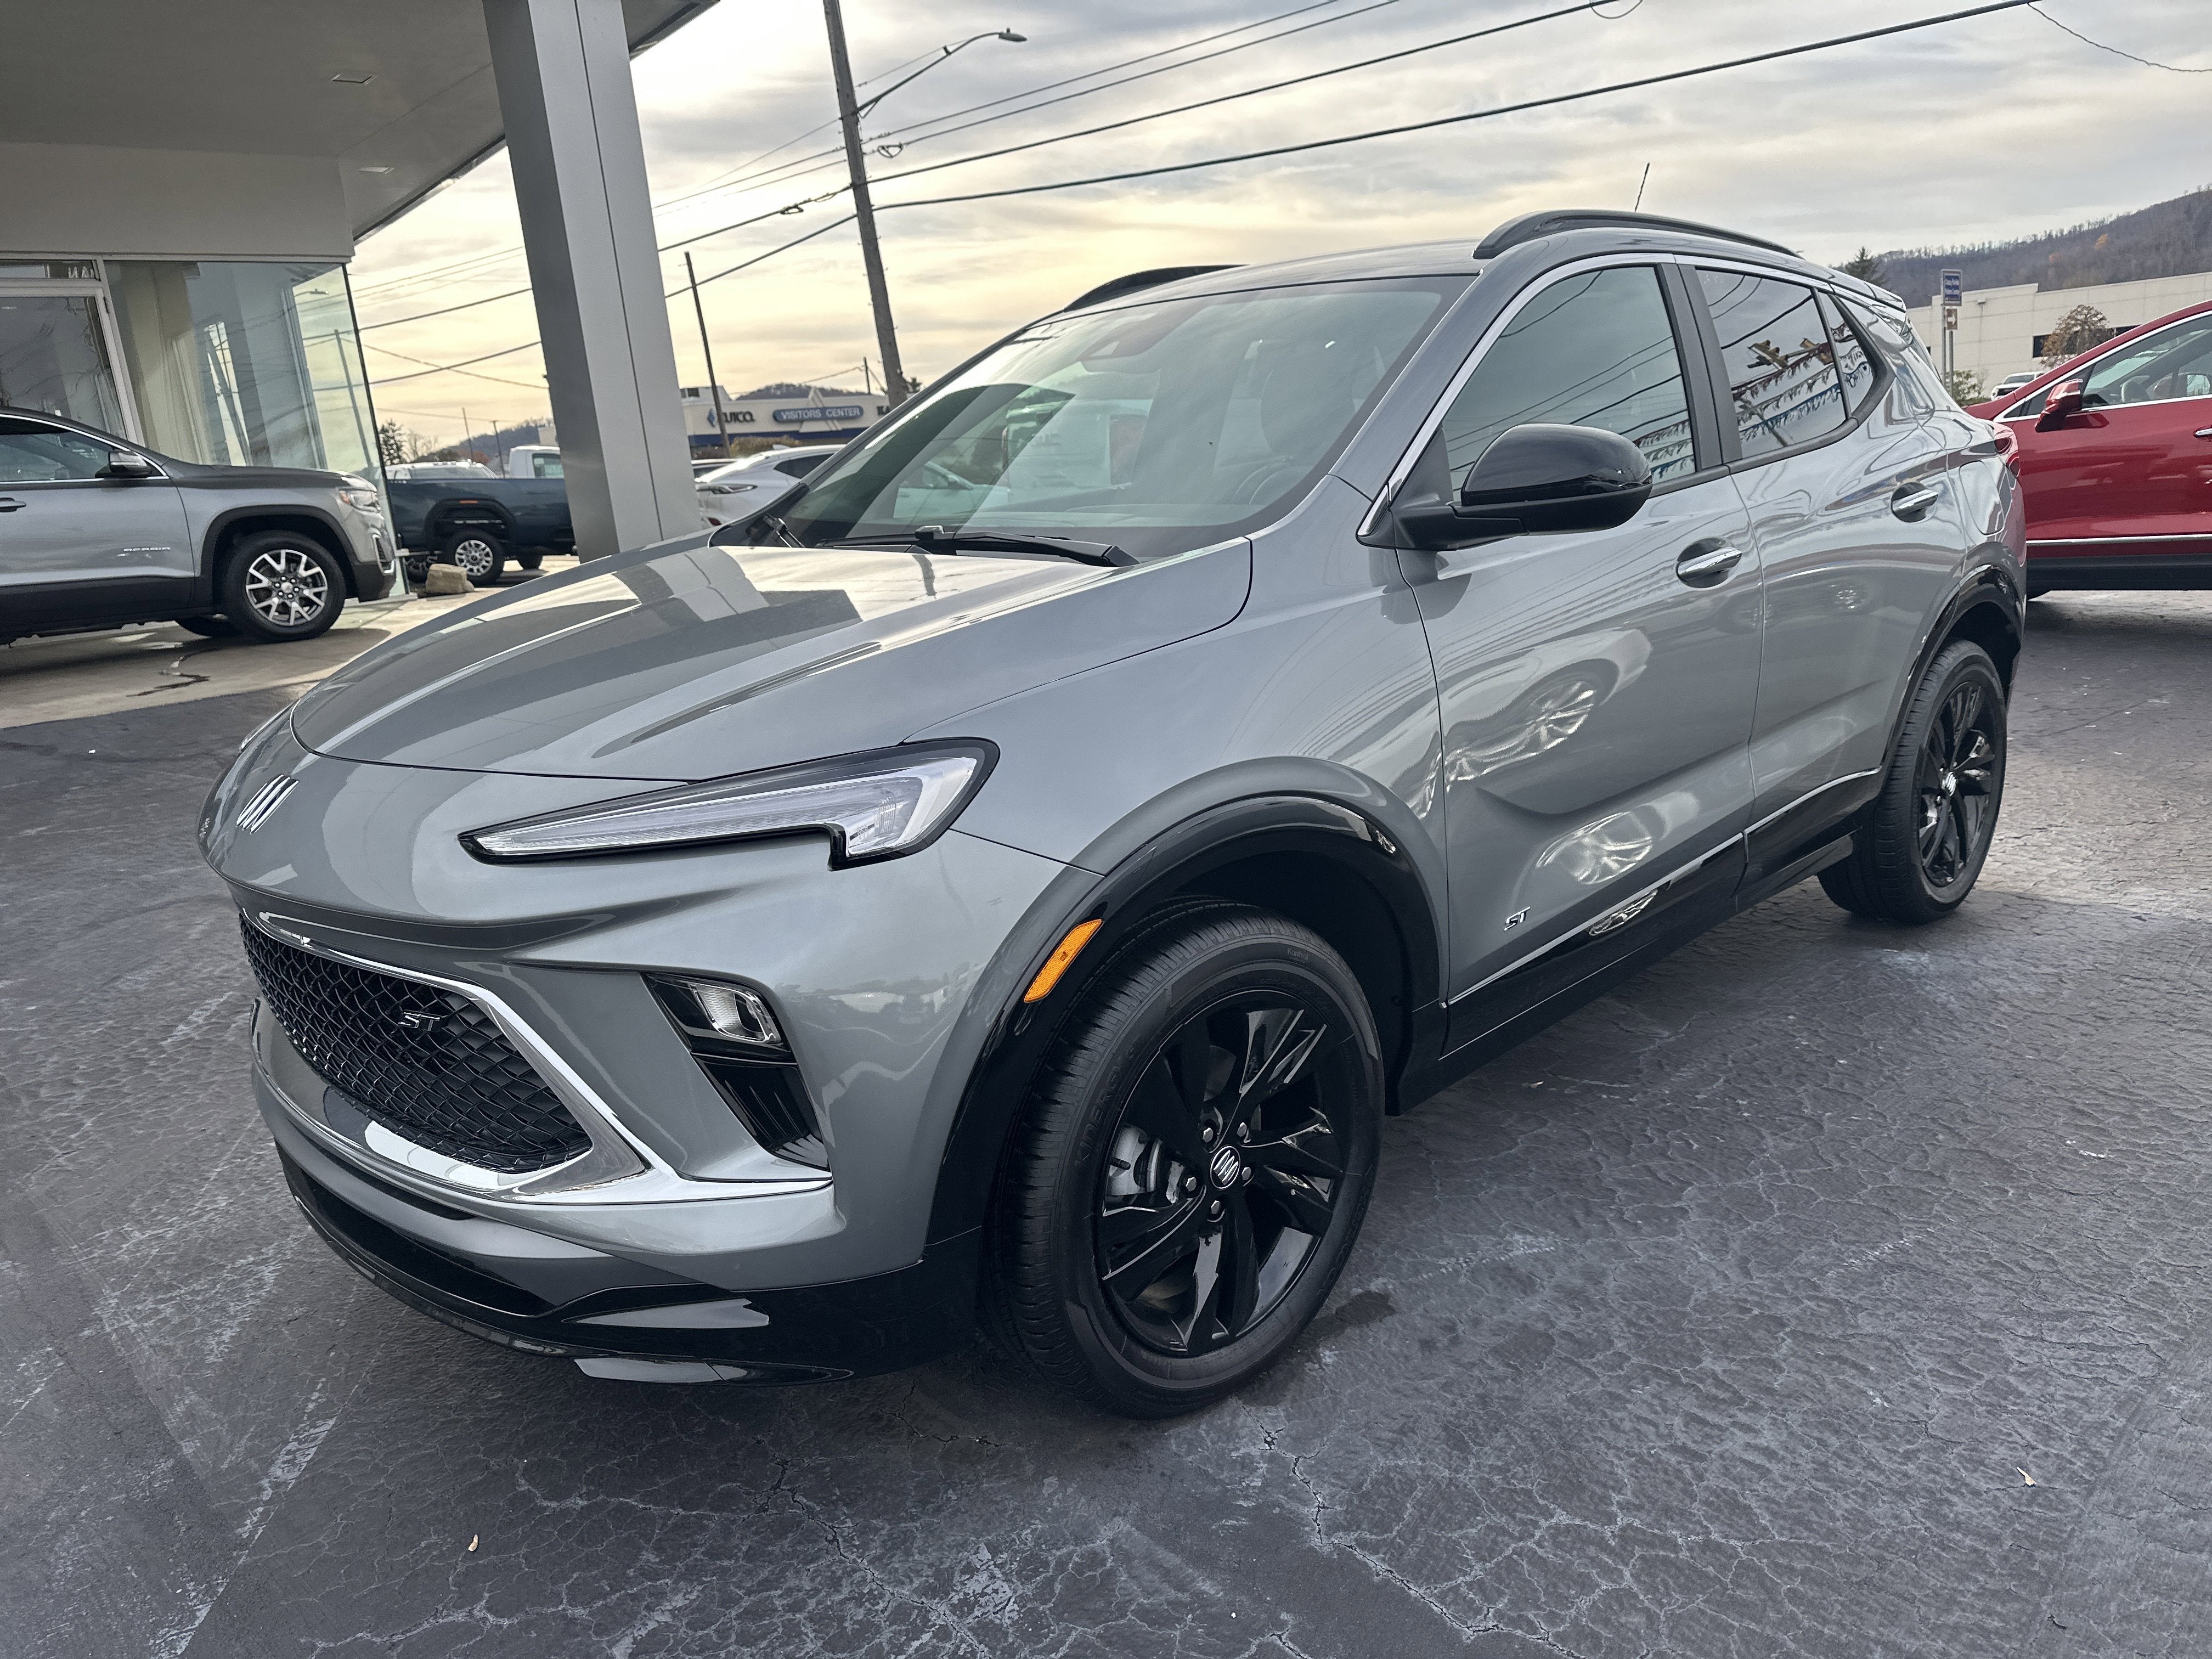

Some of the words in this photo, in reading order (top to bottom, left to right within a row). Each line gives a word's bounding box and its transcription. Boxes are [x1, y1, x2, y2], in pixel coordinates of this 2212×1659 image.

[781, 409, 822, 420] VISITORS
[825, 407, 860, 417] CENTER
[1504, 906, 1531, 931] ST
[398, 1012, 441, 1031] ST
